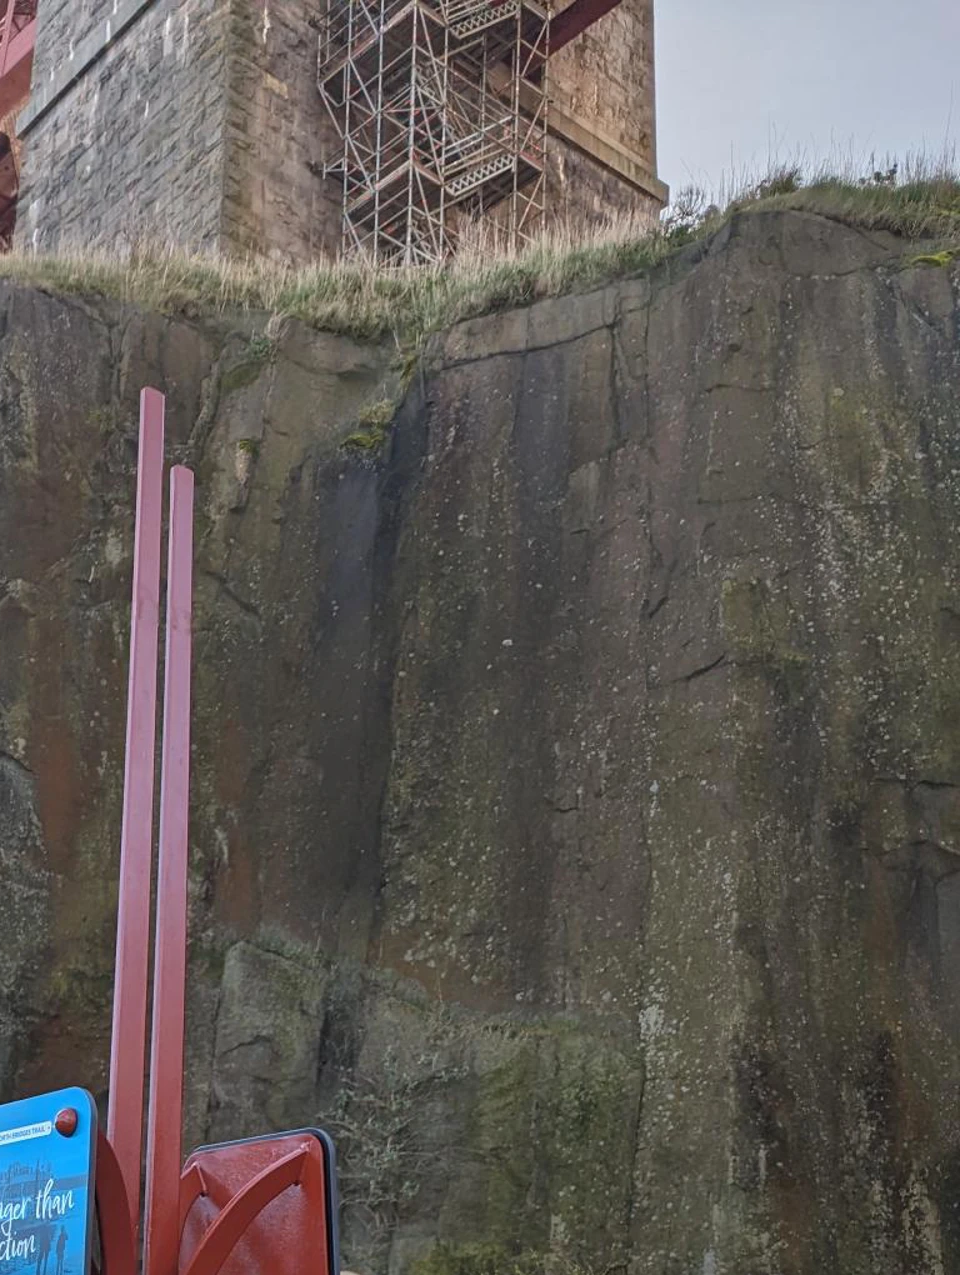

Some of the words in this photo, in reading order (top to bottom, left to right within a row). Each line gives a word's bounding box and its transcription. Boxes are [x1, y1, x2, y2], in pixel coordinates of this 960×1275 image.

[12, 1129, 31, 1139] BRIDGES
[32, 1125, 45, 1134] TRAIL
[35, 1178, 74, 1219] than
